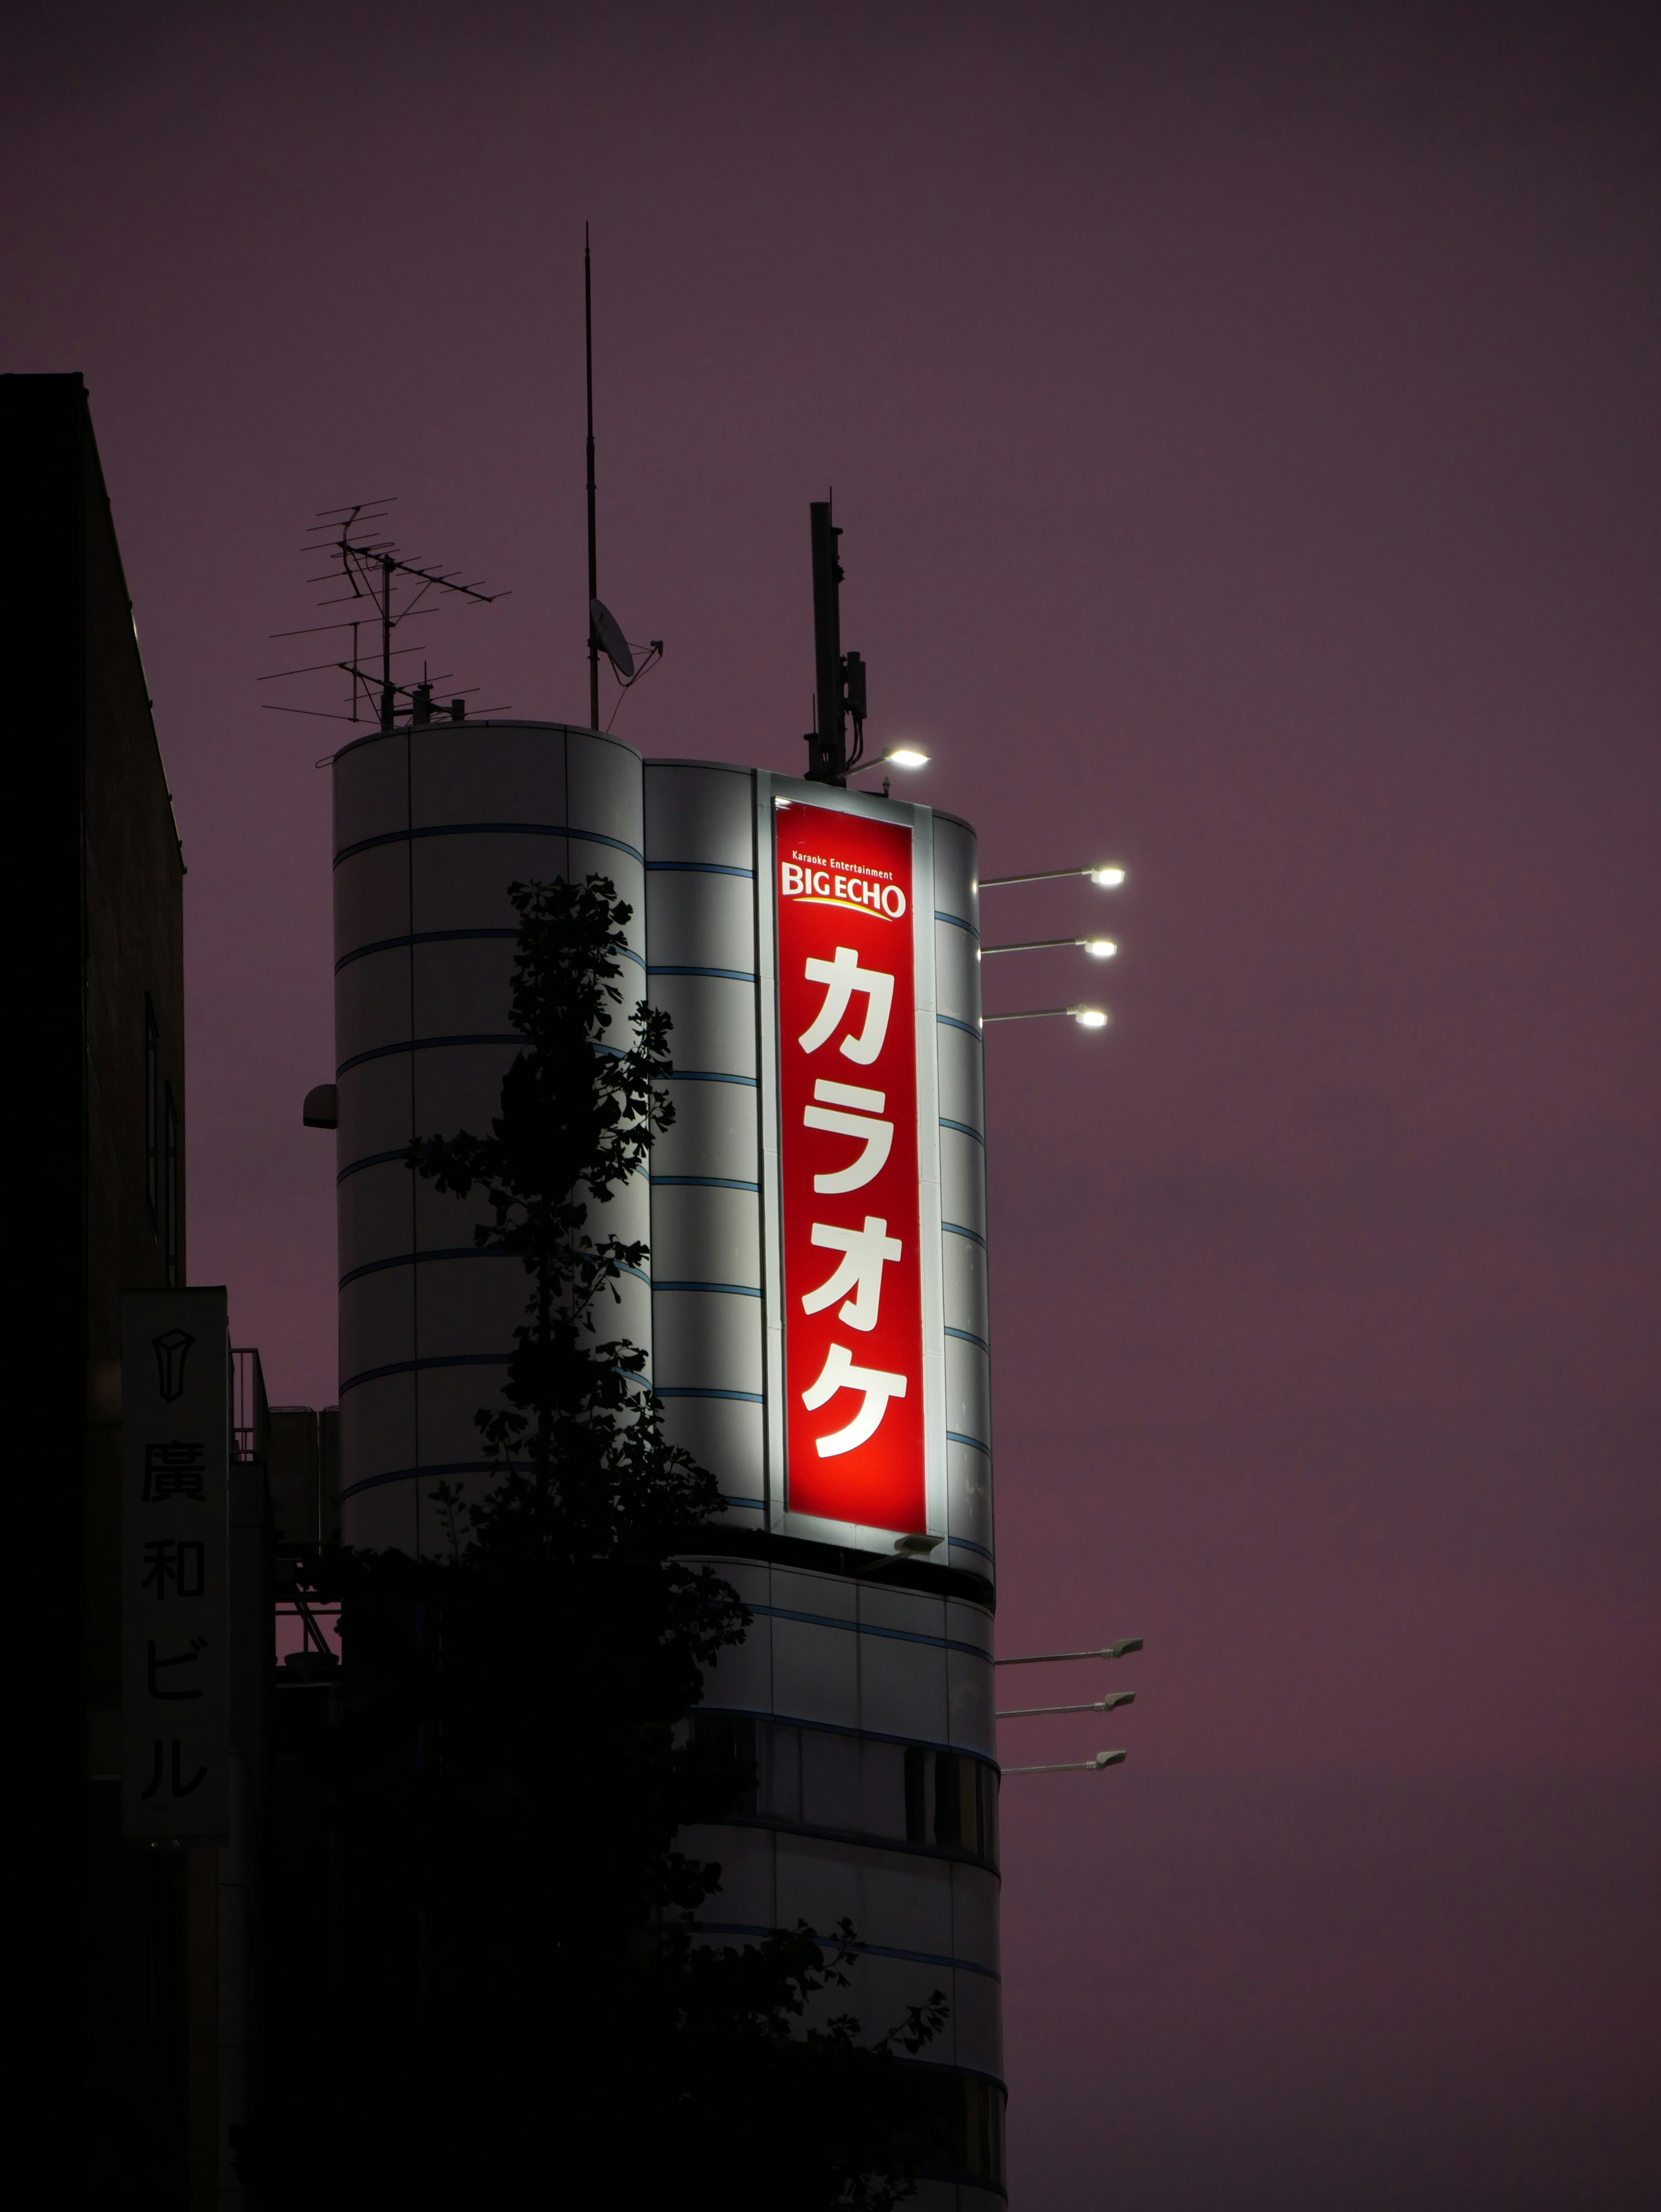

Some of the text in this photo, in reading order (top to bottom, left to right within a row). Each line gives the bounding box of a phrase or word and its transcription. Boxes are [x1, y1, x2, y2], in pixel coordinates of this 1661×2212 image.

[782, 861, 906, 918] BIG ECHO
[792, 850, 893, 881] Karaoke Entertainment
[798, 946, 908, 1459] カラオケ
[142, 1440, 208, 1800] 廣和ビル
